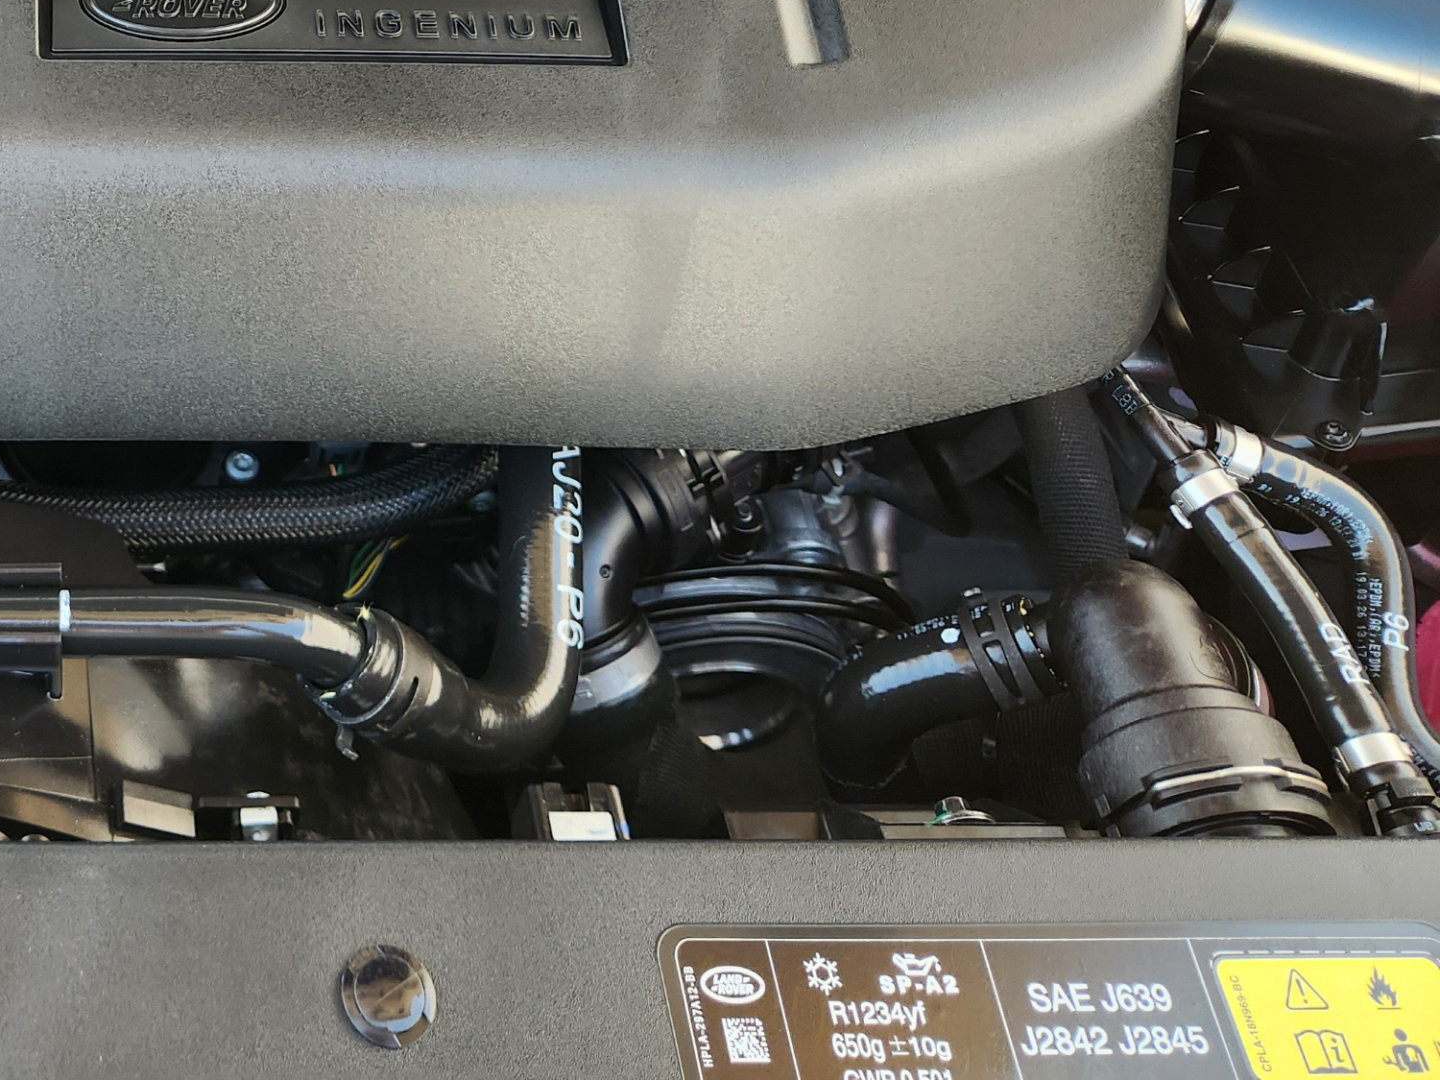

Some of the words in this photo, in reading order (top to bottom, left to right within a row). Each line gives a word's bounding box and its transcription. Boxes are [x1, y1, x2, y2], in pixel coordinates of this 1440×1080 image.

[314, 7, 584, 42] INGENIUM
[556, 583, 585, 651] P6
[1382, 611, 1410, 652] P6
[1318, 622, 1371, 684] RAD
[712, 973, 744, 986] LAND
[718, 984, 755, 996] ROVER
[878, 975, 960, 995] SP-A2
[1027, 982, 1096, 1014] SAE
[1101, 982, 1173, 1014] J639
[683, 966, 714, 1068] HPLA-297A12-BB
[827, 1000, 927, 1032] R1234yf
[1232, 973, 1273, 1073] CPLA-18N969-BC
[831, 1032, 887, 1064] 650g
[888, 1034, 953, 1062] ±10g
[1020, 1025, 1114, 1056] J2842
[1117, 1025, 1210, 1056] J2845
